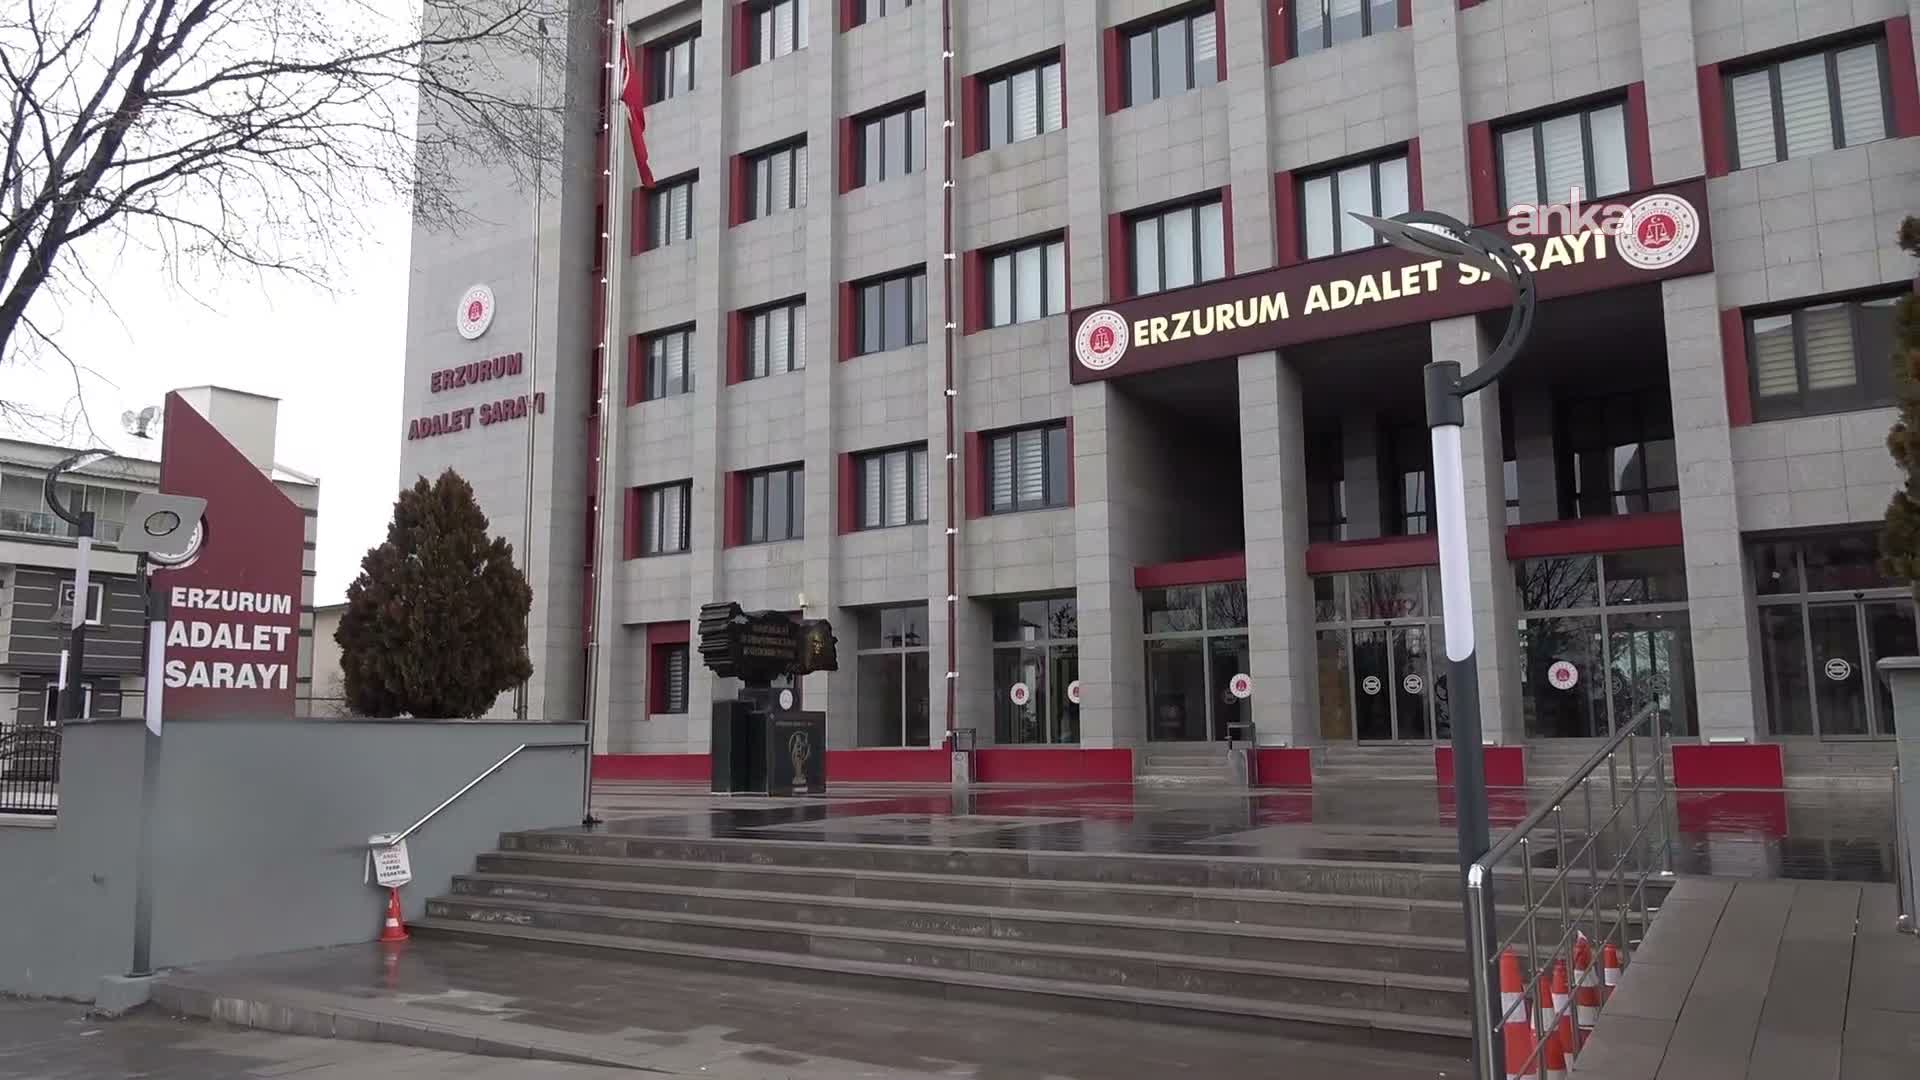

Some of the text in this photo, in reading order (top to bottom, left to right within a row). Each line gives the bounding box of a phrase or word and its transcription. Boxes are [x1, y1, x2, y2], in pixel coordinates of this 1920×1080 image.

[1134, 292, 1289, 347] ERZURUM
[1304, 260, 1443, 315] ADALET
[431, 352, 523, 393] ERZURUM
[408, 408, 474, 440] ADALET
[171, 586, 292, 615] ERZURUM
[167, 620, 292, 652] ADALET
[164, 660, 289, 690] SARAYI
